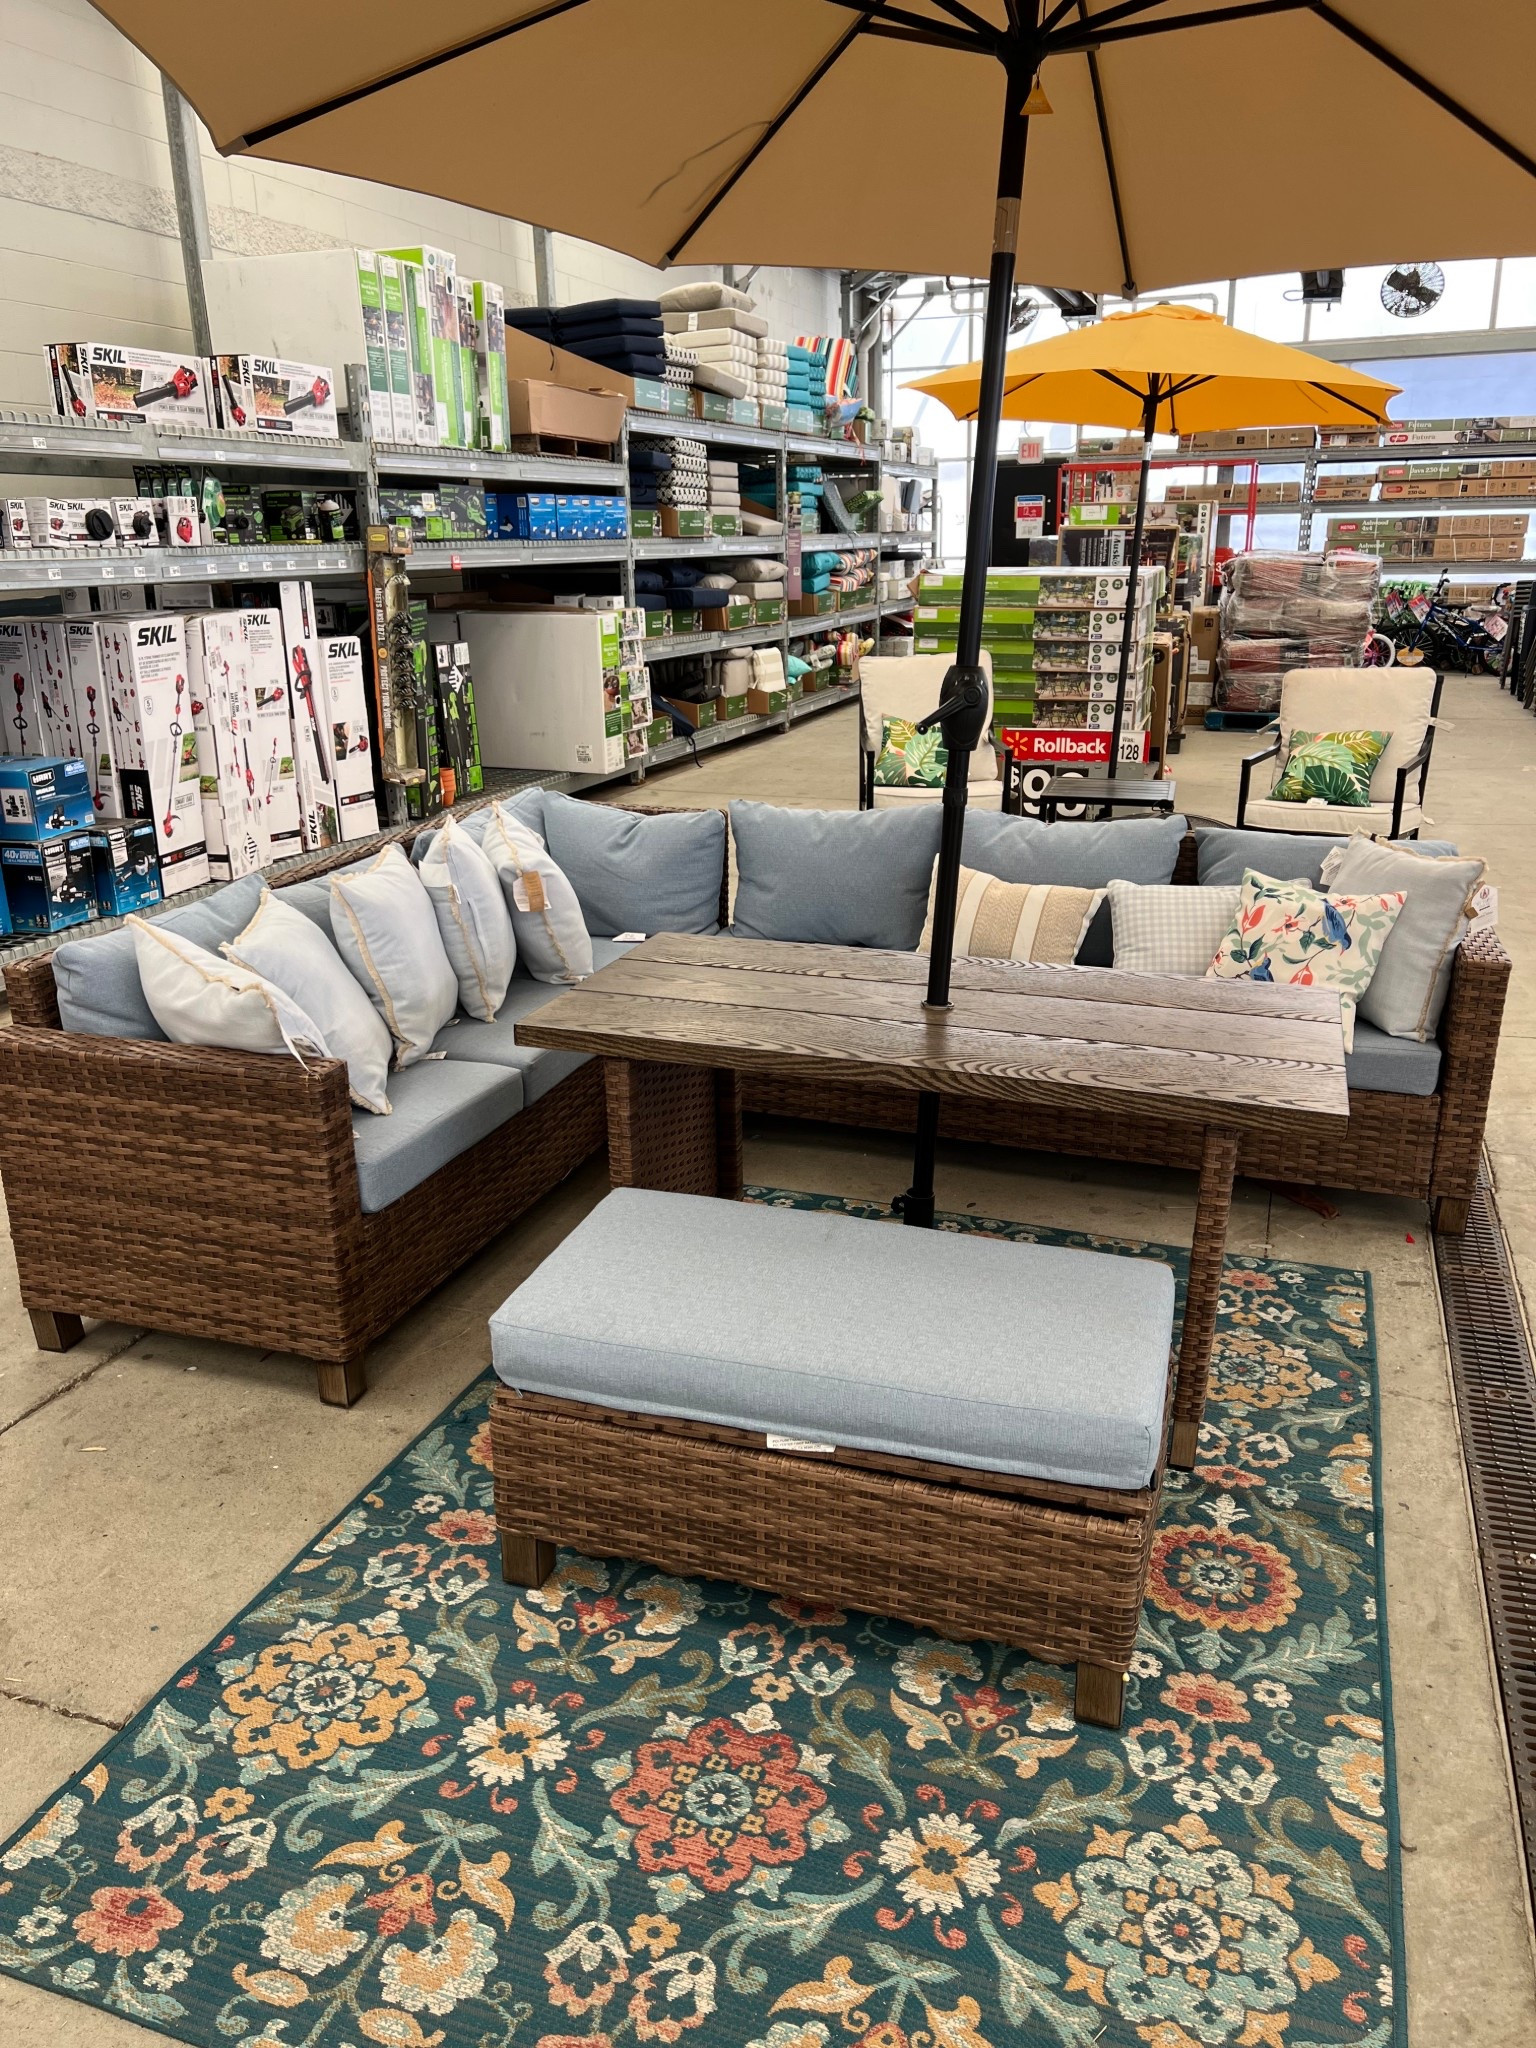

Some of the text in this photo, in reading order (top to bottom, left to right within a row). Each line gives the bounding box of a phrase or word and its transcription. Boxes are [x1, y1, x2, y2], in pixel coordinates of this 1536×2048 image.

[79, 347, 90, 376] SKIL
[92, 347, 127, 364] SKIL
[241, 359, 251, 387] SKIL
[253, 359, 279, 375] SKIL
[1021, 443, 1040, 458] EXIT
[10, 501, 24, 510] SKIL
[49, 501, 67, 511] SKIL
[67, 502, 86, 511] SKIL
[119, 503, 134, 511] SKIL
[375, 587, 383, 608] MEETS
[376, 609, 384, 623] ANSI
[69, 625, 93, 636] SKIL
[137, 624, 177, 647] SKIL
[328, 642, 360, 659] SKIL
[380, 665, 389, 691] PROTECT
[382, 691, 390, 707] YOUR
[1033, 737, 1107, 754] Rollback
[32, 770, 54, 784] HART
[134, 784, 145, 811] SKIL
[310, 811, 320, 845] SKIL
[44, 844, 64, 856] HART
